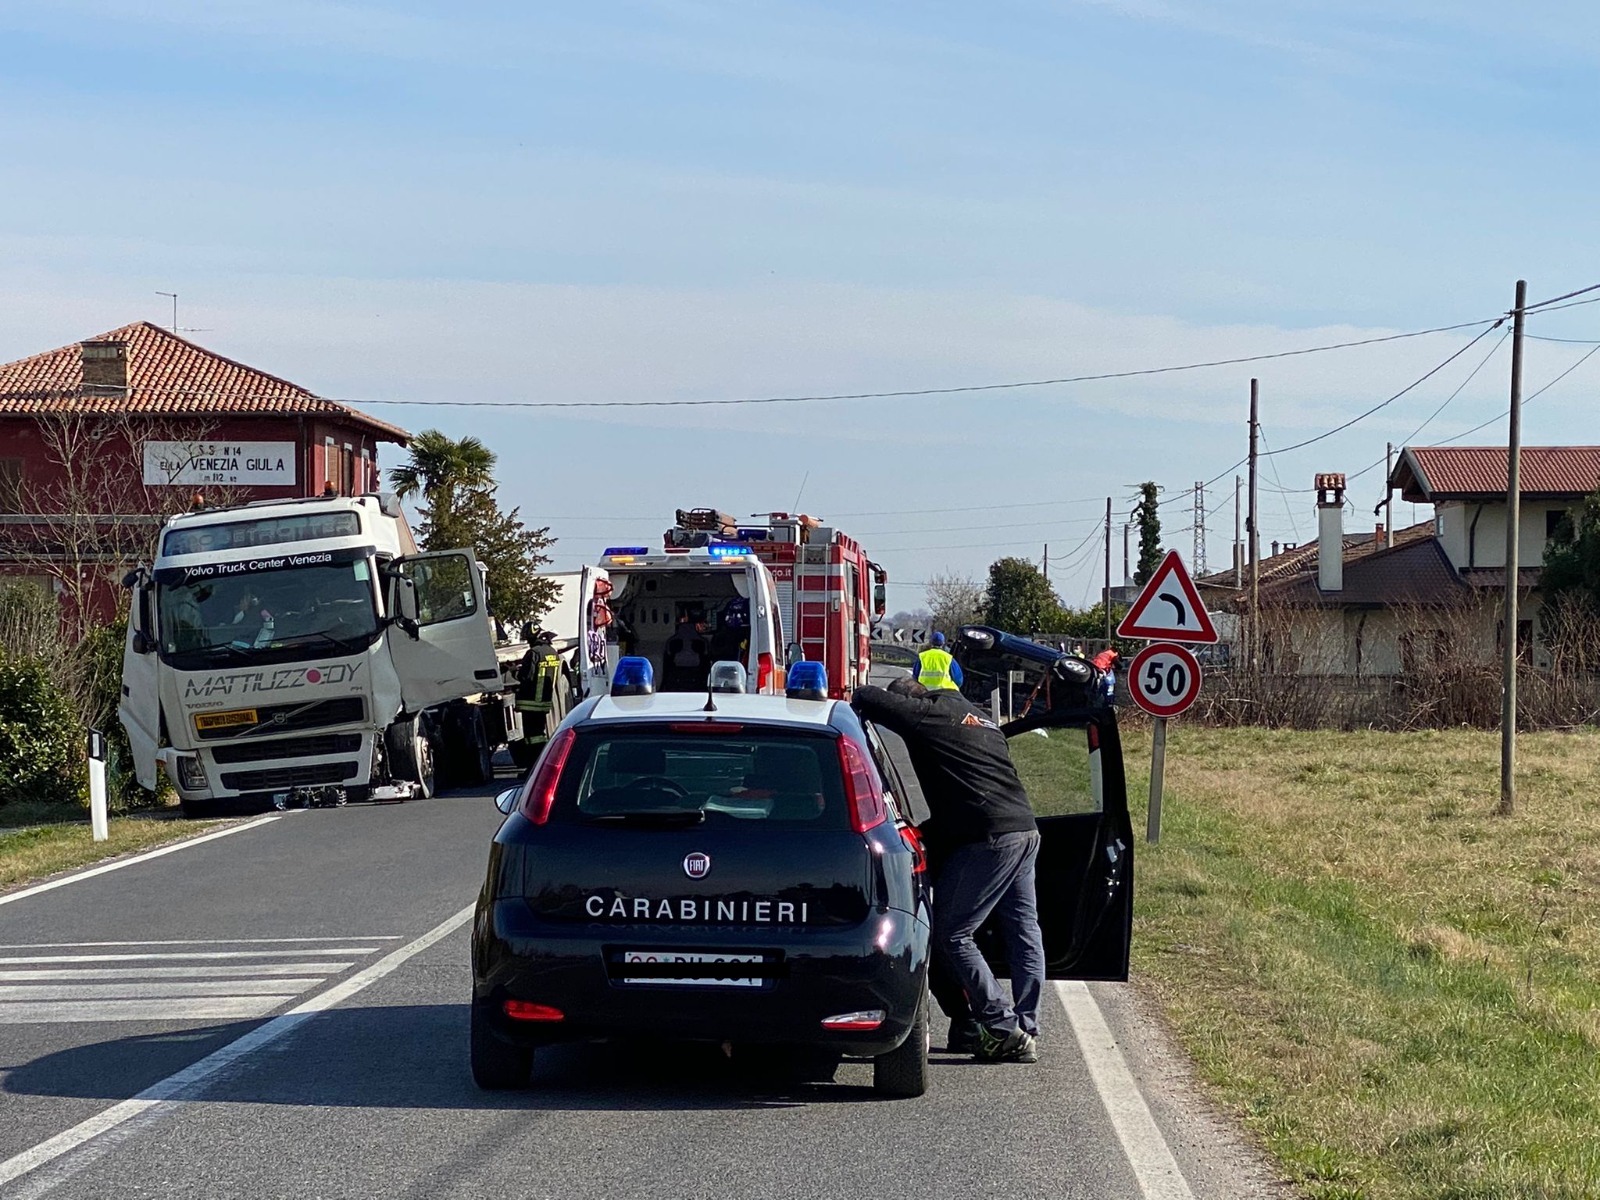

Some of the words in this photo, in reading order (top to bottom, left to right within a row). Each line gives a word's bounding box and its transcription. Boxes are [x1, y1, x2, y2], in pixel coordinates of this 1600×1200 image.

[191, 458, 239, 470] VENEZIA
[185, 566, 214, 577] Volvo
[216, 562, 246, 573] Truck
[249, 559, 285, 571] Center
[288, 552, 332, 566] Venezia
[1144, 662, 1186, 697] 50
[184, 701, 225, 709] VOLVO
[689, 859, 704, 871] FIAT
[585, 895, 807, 923] CARABINIERI
